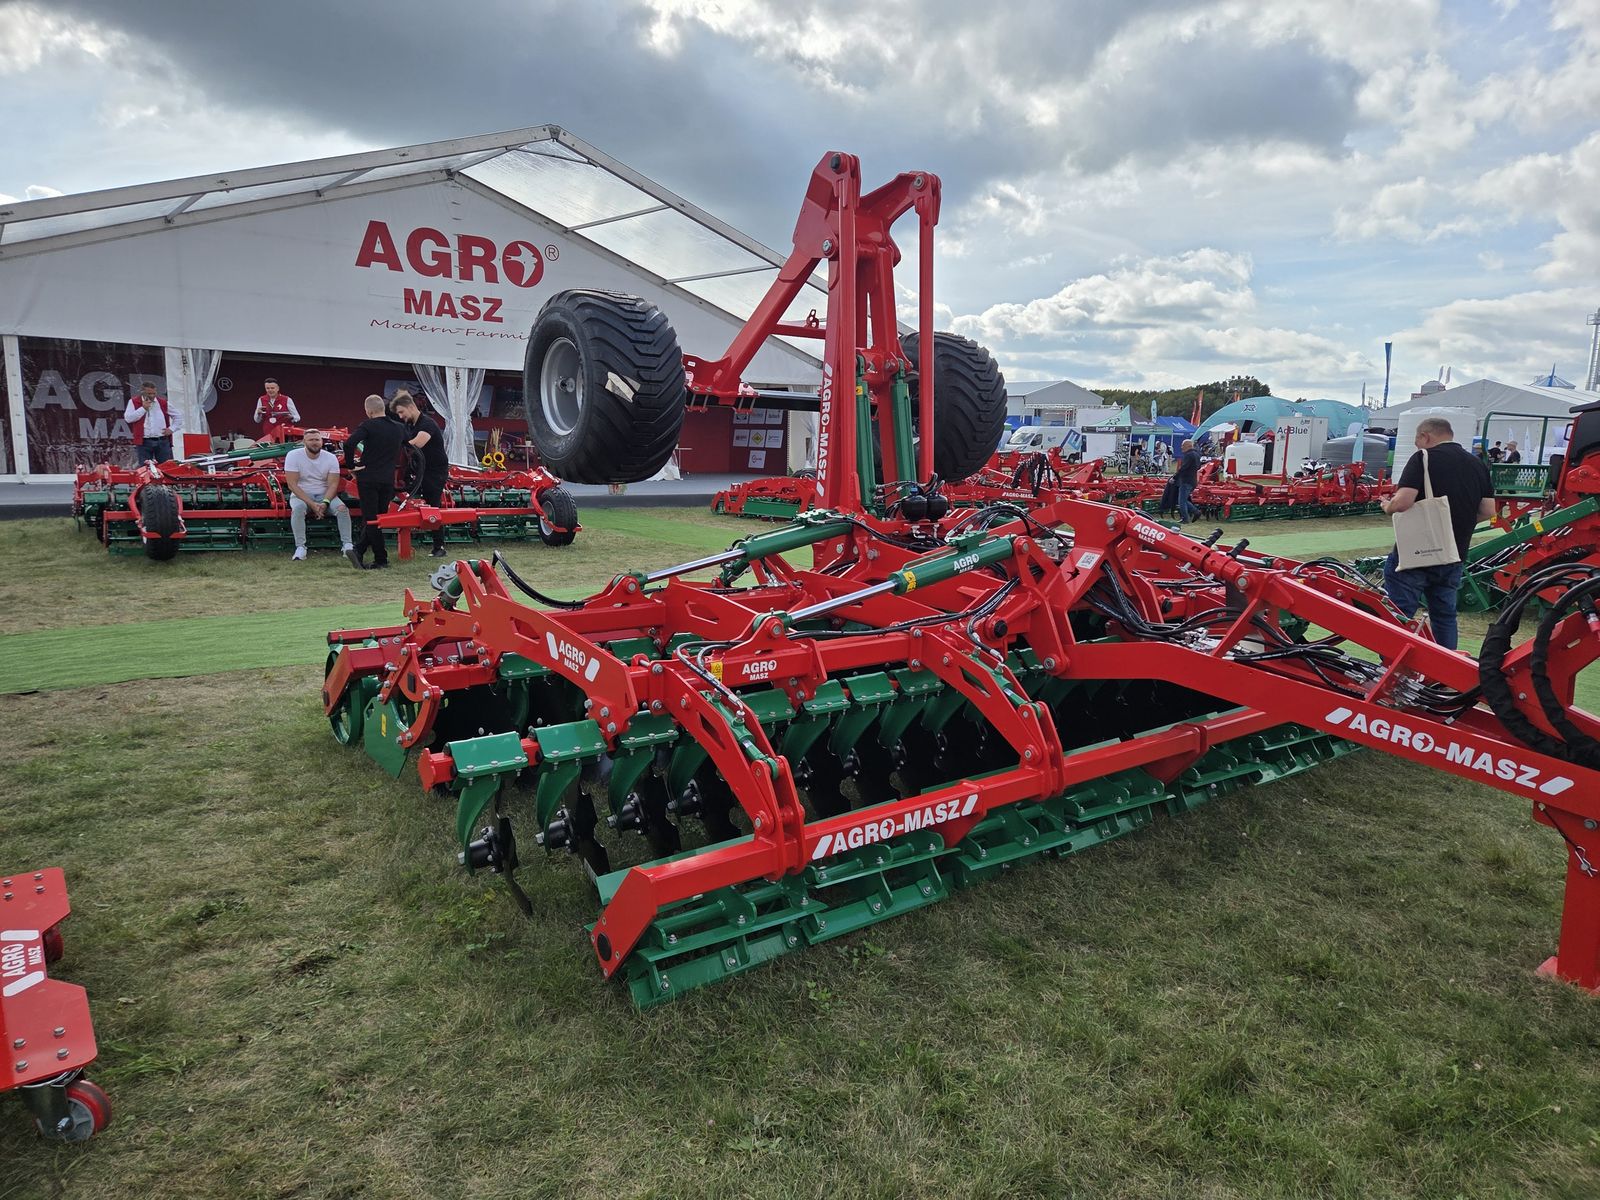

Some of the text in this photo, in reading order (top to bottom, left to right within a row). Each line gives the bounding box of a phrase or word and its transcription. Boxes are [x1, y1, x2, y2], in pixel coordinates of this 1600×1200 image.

[355, 220, 544, 288] AGRO
[403, 288, 503, 323] MASZ
[370, 319, 529, 340] Modern Farmi
[79, 417, 133, 439] MA
[817, 377, 832, 480] AGRO-MASZ
[1133, 522, 1166, 541] AGRO
[953, 553, 980, 571] AGRO
[559, 639, 586, 667] AGRO
[564, 657, 579, 673] MASZ
[741, 660, 777, 675] AGRO
[1348, 713, 1541, 789] AGRO-MASZ
[832, 800, 960, 855] AGRO-MASZ
[1, 943, 26, 977] AGRO
